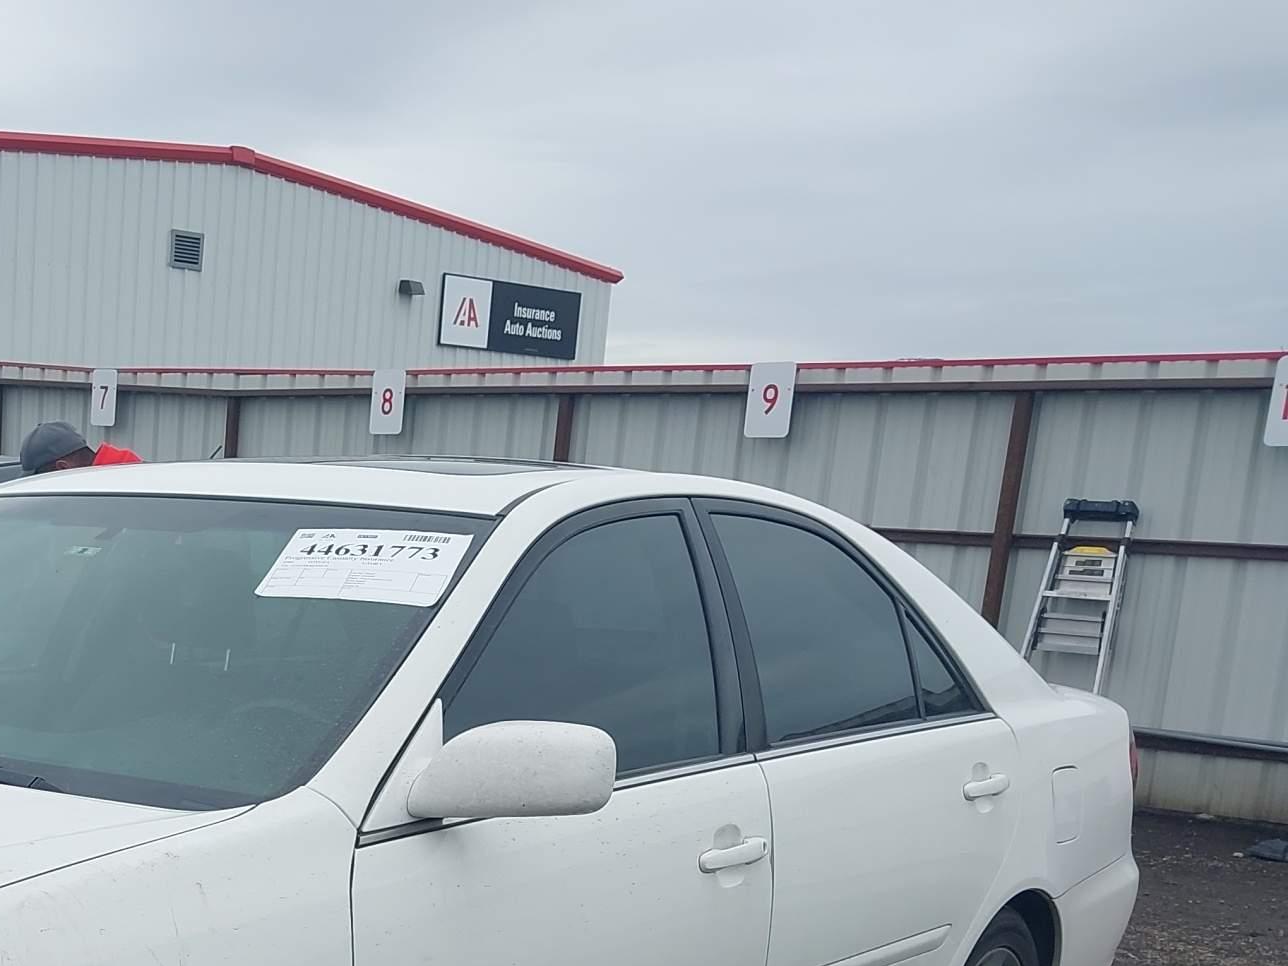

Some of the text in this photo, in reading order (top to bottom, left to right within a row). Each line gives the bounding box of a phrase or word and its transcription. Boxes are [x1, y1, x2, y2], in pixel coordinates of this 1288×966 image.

[513, 302, 555, 322] Insurance
[503, 319, 562, 341] Auto Auctions
[99, 386, 108, 410] 7
[381, 388, 393, 415] 8
[763, 384, 779, 415] 9
[300, 543, 440, 561] 44631773
